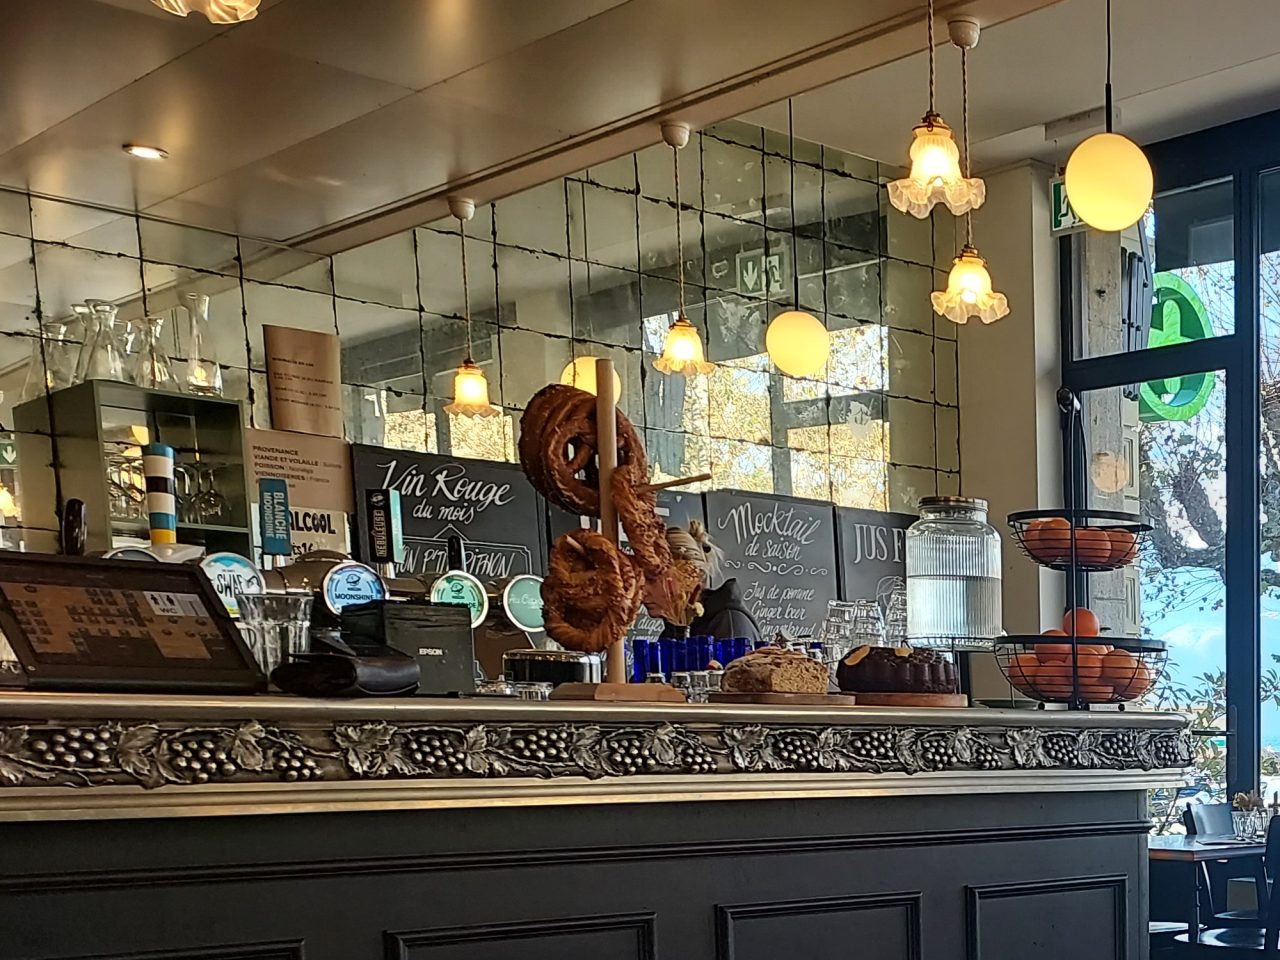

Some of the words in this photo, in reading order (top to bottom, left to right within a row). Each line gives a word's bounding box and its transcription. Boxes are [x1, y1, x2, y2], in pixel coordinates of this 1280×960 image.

[252, 446, 299, 456] PROVENANCE
[254, 454, 279, 462] VIANDE
[289, 458, 319, 467] VOLAILLE
[254, 462, 285, 471] POISSON
[254, 470, 306, 481] VIENNOISERIES
[376, 459, 428, 497] Vin
[431, 463, 516, 512] Rouge
[263, 492, 274, 538] MOONSHINE
[273, 492, 287, 540] BLANCHE
[412, 498, 433, 519] du
[437, 502, 476, 524] mois
[717, 502, 822, 545] Mocktail
[745, 535, 760, 557] de
[762, 537, 803, 562] saison
[854, 523, 888, 564] JUS
[334, 593, 375, 601] MOONSHINE
[743, 581, 766, 601] Jus
[767, 584, 780, 599] de
[779, 587, 815, 604] pomme
[160, 607, 178, 615] WC
[752, 600, 782, 620] Ginger
[785, 603, 807, 620] beer
[418, 648, 443, 656] EPSON
